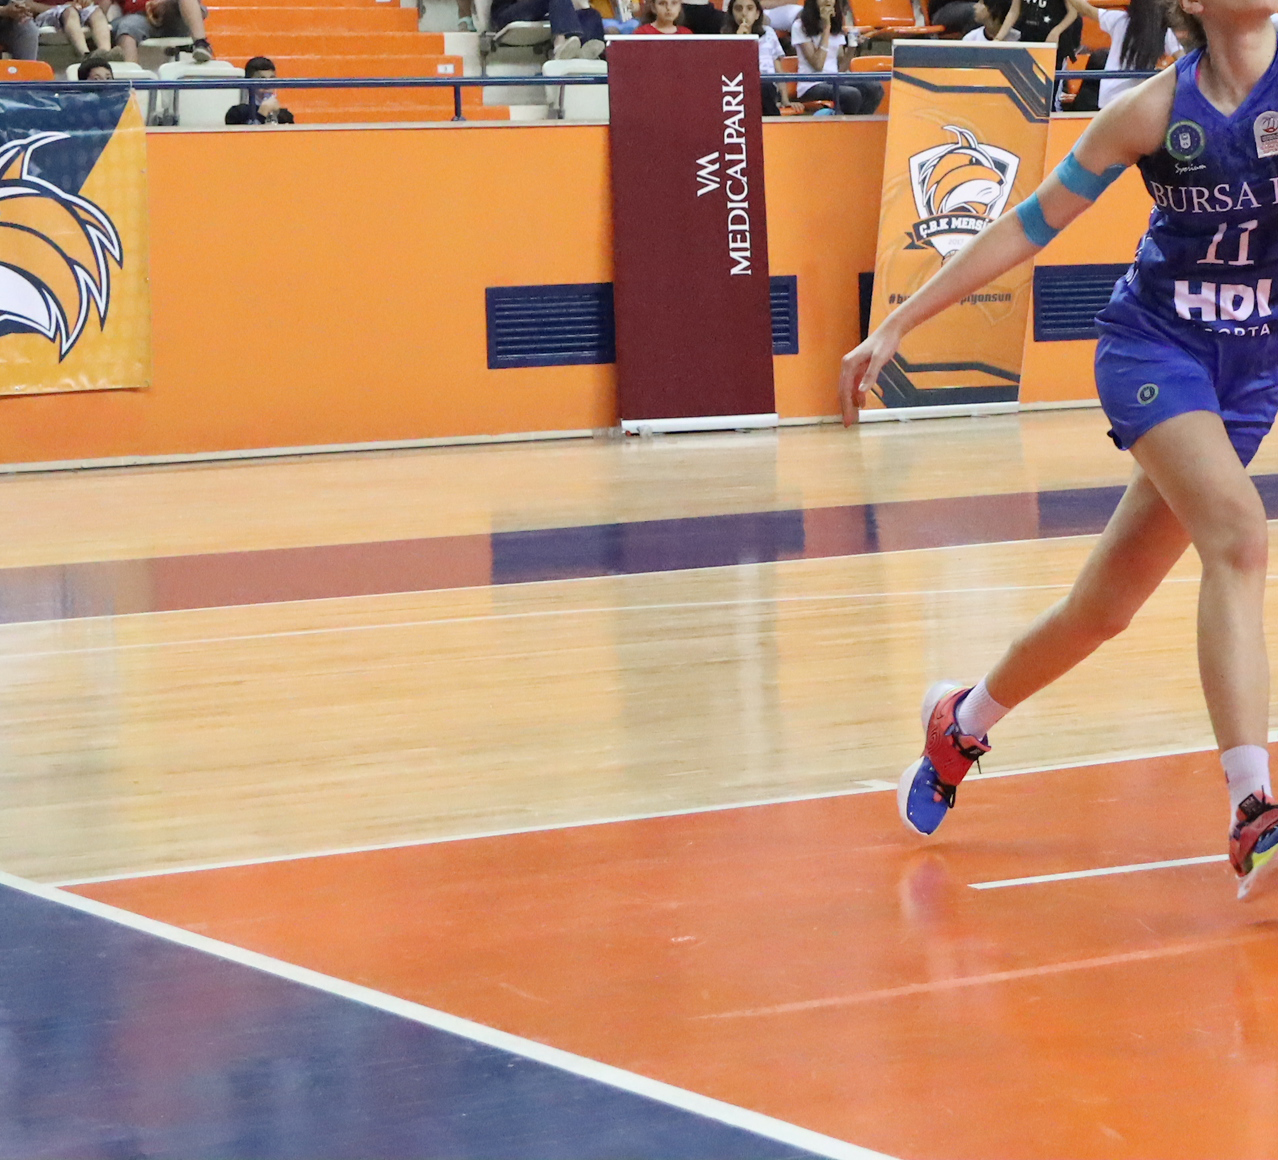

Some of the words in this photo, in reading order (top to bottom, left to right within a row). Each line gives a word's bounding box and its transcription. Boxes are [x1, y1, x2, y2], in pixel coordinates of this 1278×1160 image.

[721, 72, 751, 275] MEDICALPARK
[1151, 181, 1262, 213] BURSA
[918, 218, 950, 239] Ç.B.K
[950, 217, 993, 232] MERSİ
[1196, 219, 1259, 266] 11
[1173, 278, 1273, 322] HDI
